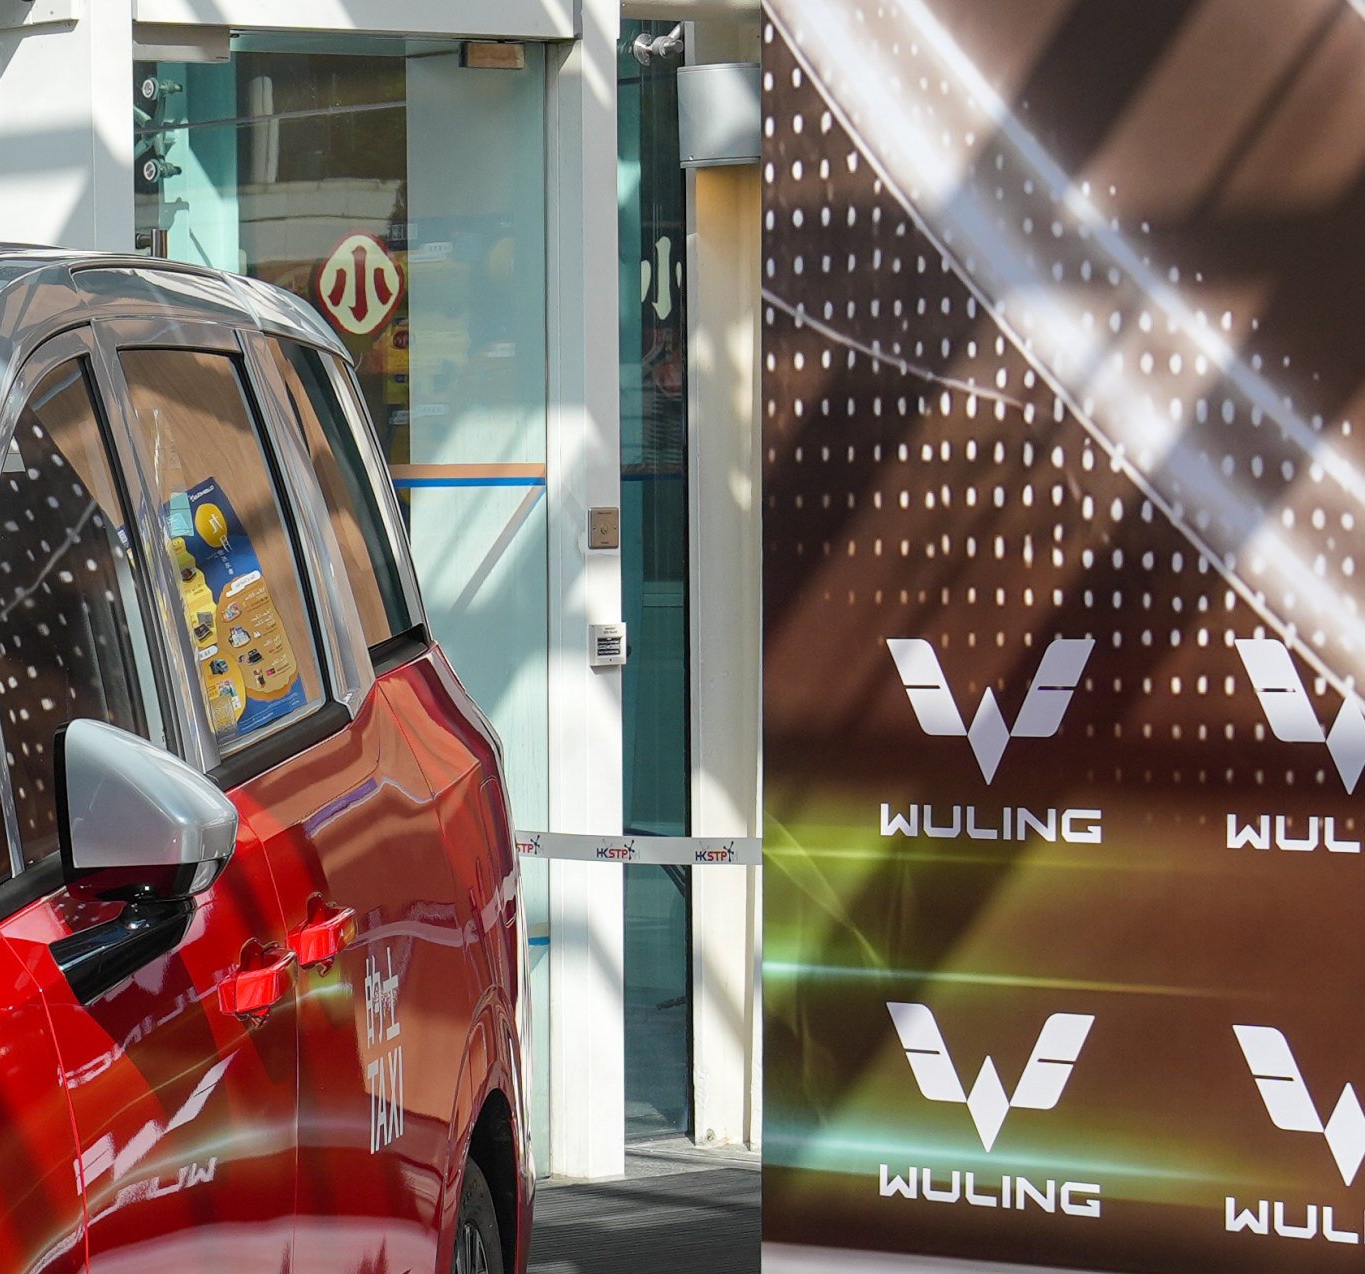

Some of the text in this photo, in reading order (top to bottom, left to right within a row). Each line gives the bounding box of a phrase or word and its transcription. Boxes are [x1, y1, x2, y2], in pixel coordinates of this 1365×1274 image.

[328, 245, 393, 322] 小
[880, 803, 1102, 844] WULING
[596, 847, 629, 860] HKSTP
[695, 850, 728, 862] HKSTP
[365, 947, 401, 1049] 的士
[368, 1046, 404, 1154] TAXI
[879, 1163, 1101, 1219] WULING
[1225, 1197, 1365, 1245] WUL
